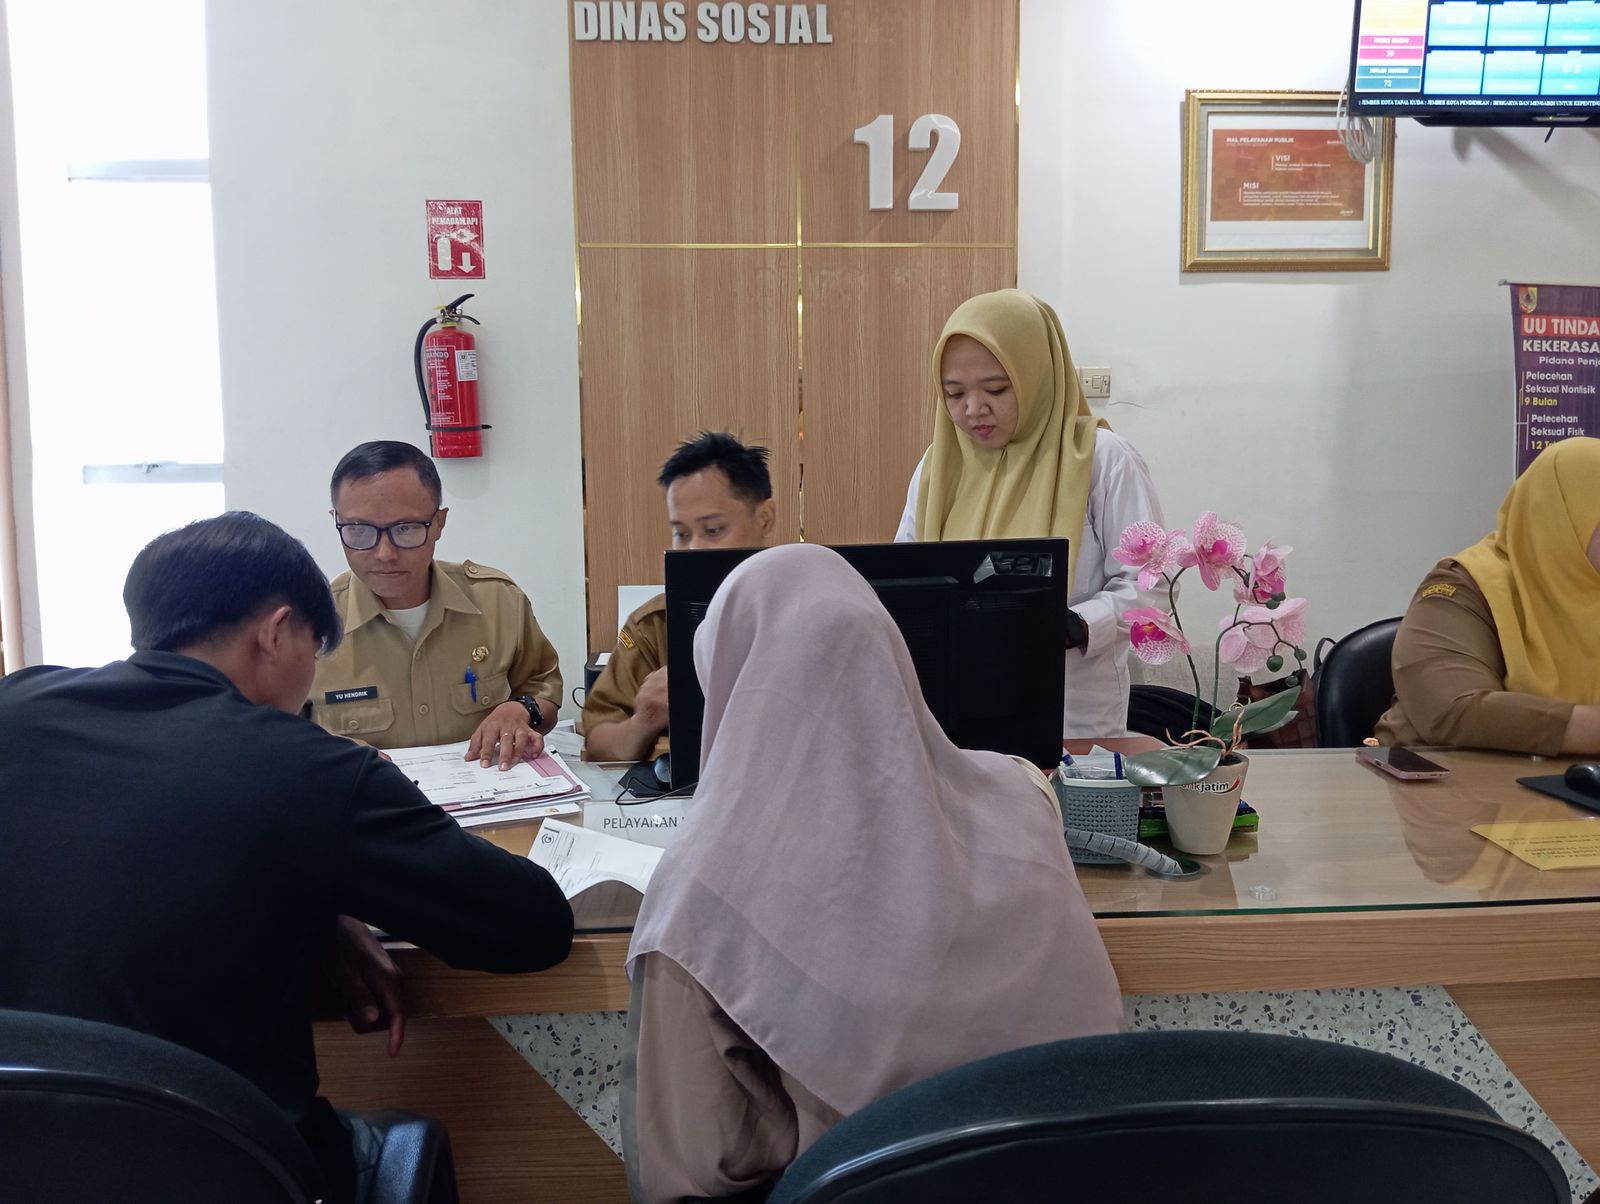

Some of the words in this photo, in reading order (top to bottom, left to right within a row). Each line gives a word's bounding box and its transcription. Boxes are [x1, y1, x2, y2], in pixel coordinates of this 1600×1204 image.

[574, 1, 686, 41] DINAS
[697, 1, 833, 44] SOSIAL
[854, 114, 961, 212] 12
[1523, 317, 1547, 334] UU
[1551, 318, 1600, 336] TINDA
[1539, 356, 1574, 365] Pidana
[1526, 371, 1573, 380] Pelecehan
[1525, 384, 1559, 393] Seksual
[1524, 397, 1530, 406] 9
[1532, 397, 1558, 406] Bulan
[1531, 414, 1578, 423] Pelecehan
[1530, 427, 1565, 436] Seksual
[1567, 427, 1585, 436] Fisik
[1531, 441, 1543, 450] 12
